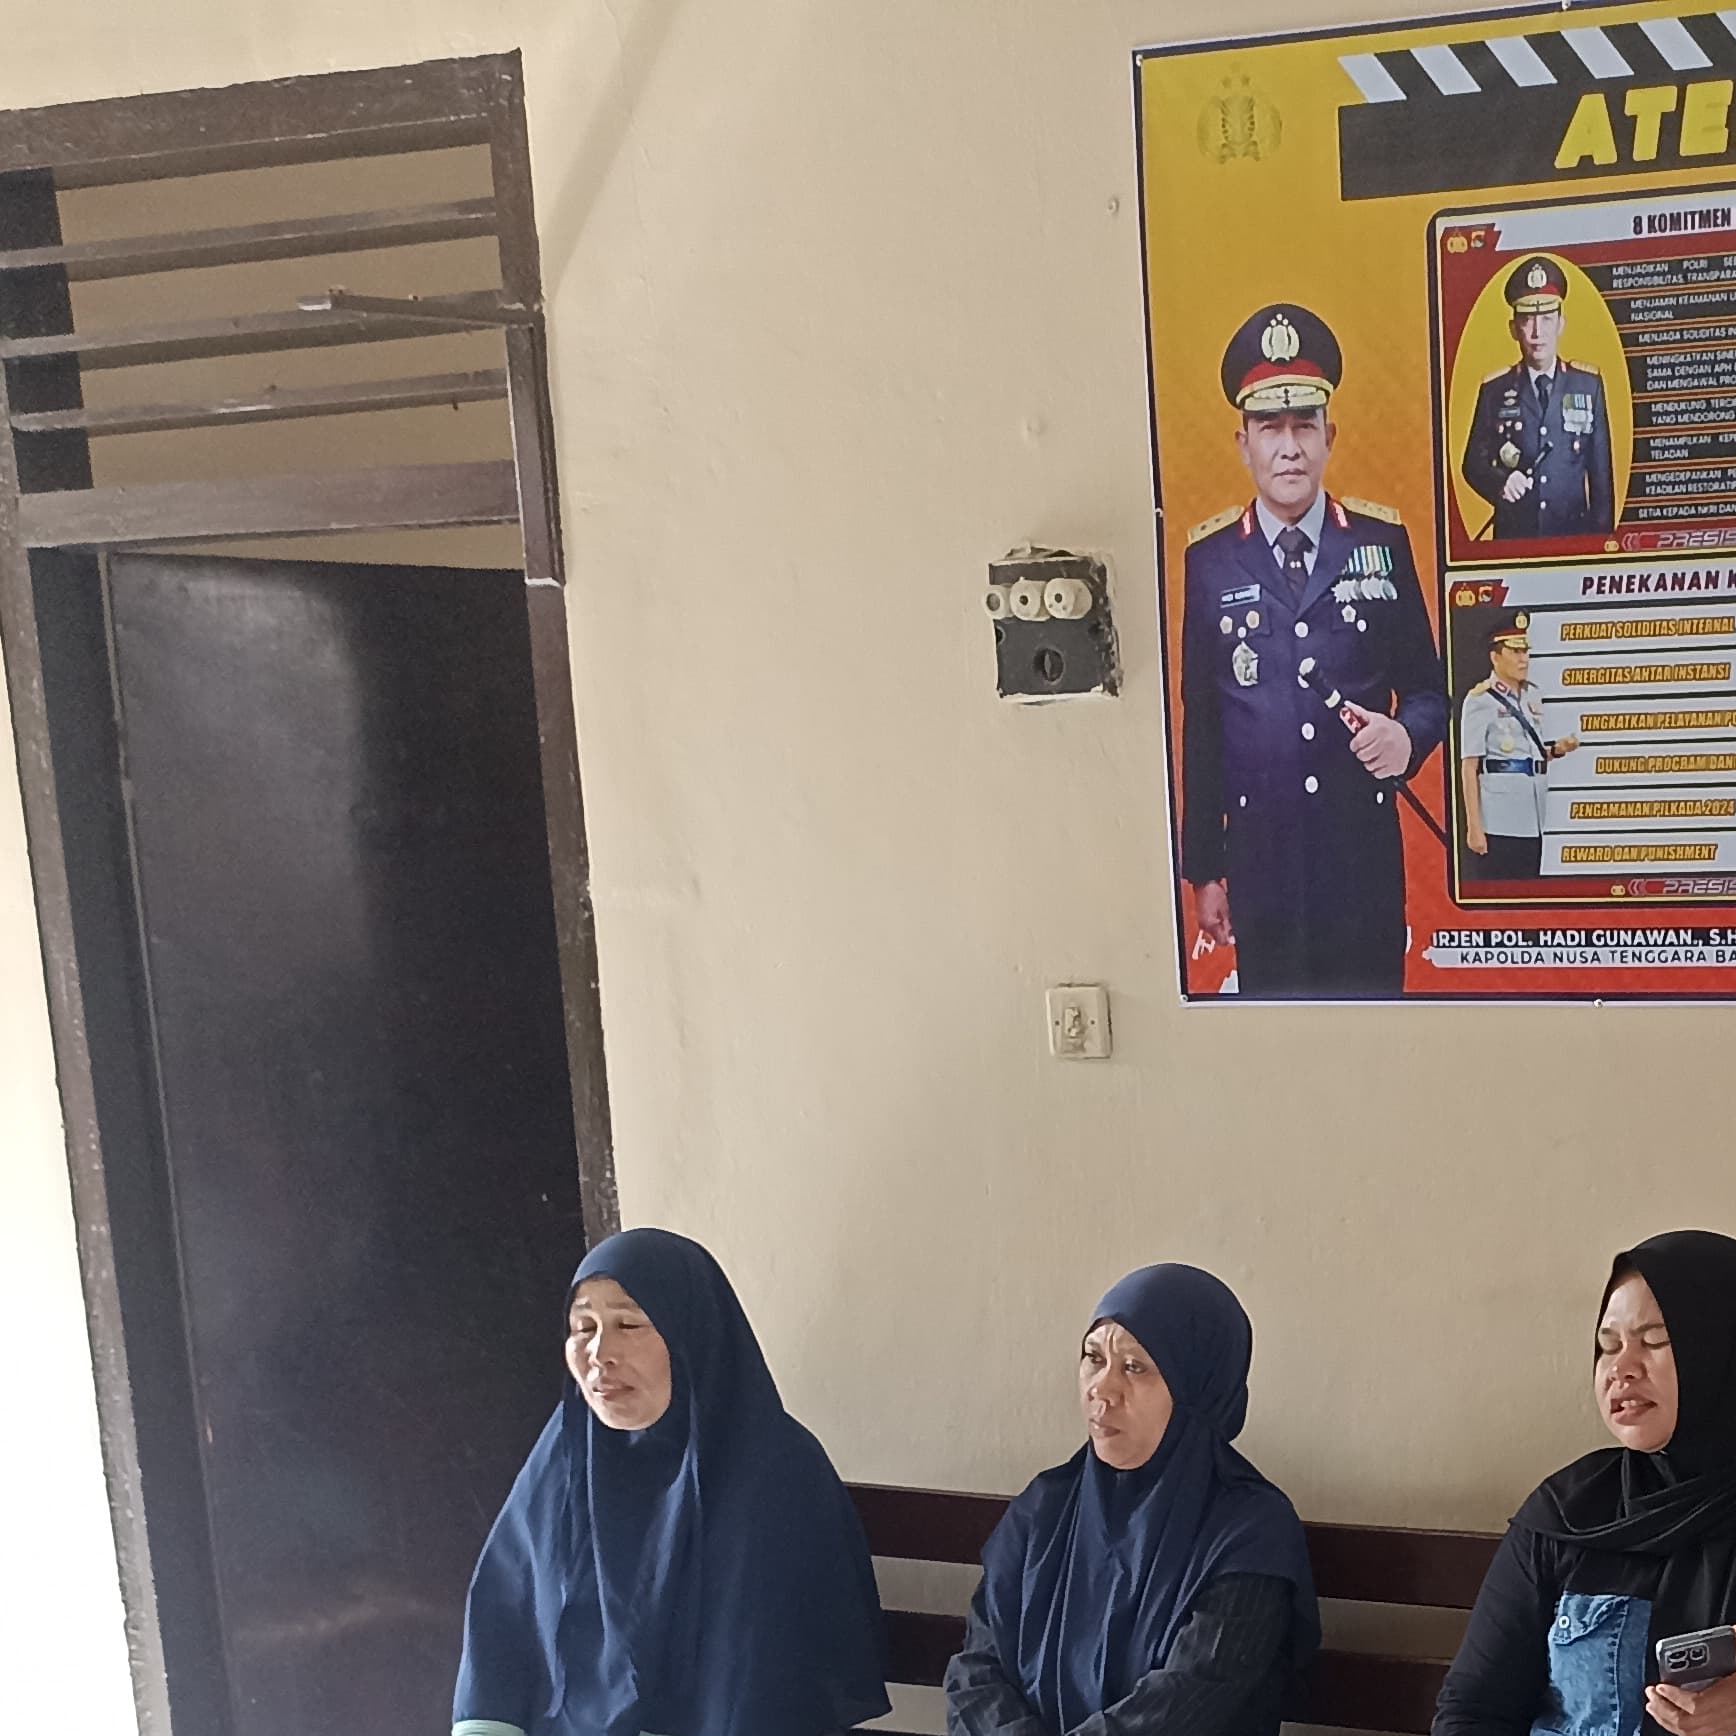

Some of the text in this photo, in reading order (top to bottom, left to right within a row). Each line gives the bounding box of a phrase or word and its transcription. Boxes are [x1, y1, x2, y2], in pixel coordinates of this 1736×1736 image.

[1633, 215, 1643, 235] 8
[1647, 207, 1731, 233] KOMITMEN
[1581, 570, 1720, 595] PENEKANAN
[1561, 616, 1736, 641] PERKUAT SOLIDITAS INTERNAL
[1562, 662, 1731, 685] SINERGITAS ANTAR INSTANSI
[1581, 713, 1654, 732] TINGKATKAN
[1655, 710, 1724, 730] PELAYANAN
[1596, 756, 1646, 774] DUKUNG
[1648, 754, 1707, 773] PROGRAM
[1709, 753, 1735, 771] DAN
[1570, 799, 1736, 819] PENGAMANAN PILKADA 2024
[1561, 843, 1718, 863] REWARD DAN PUNISHMENT
[1432, 931, 1484, 947] IRJEN
[1490, 932, 1534, 947] POL.
[1540, 930, 1586, 946] HADI
[1460, 950, 1545, 965] KAPOLDA
[1553, 950, 1601, 964] NUSA
[1609, 949, 1706, 964] TENGGARA
